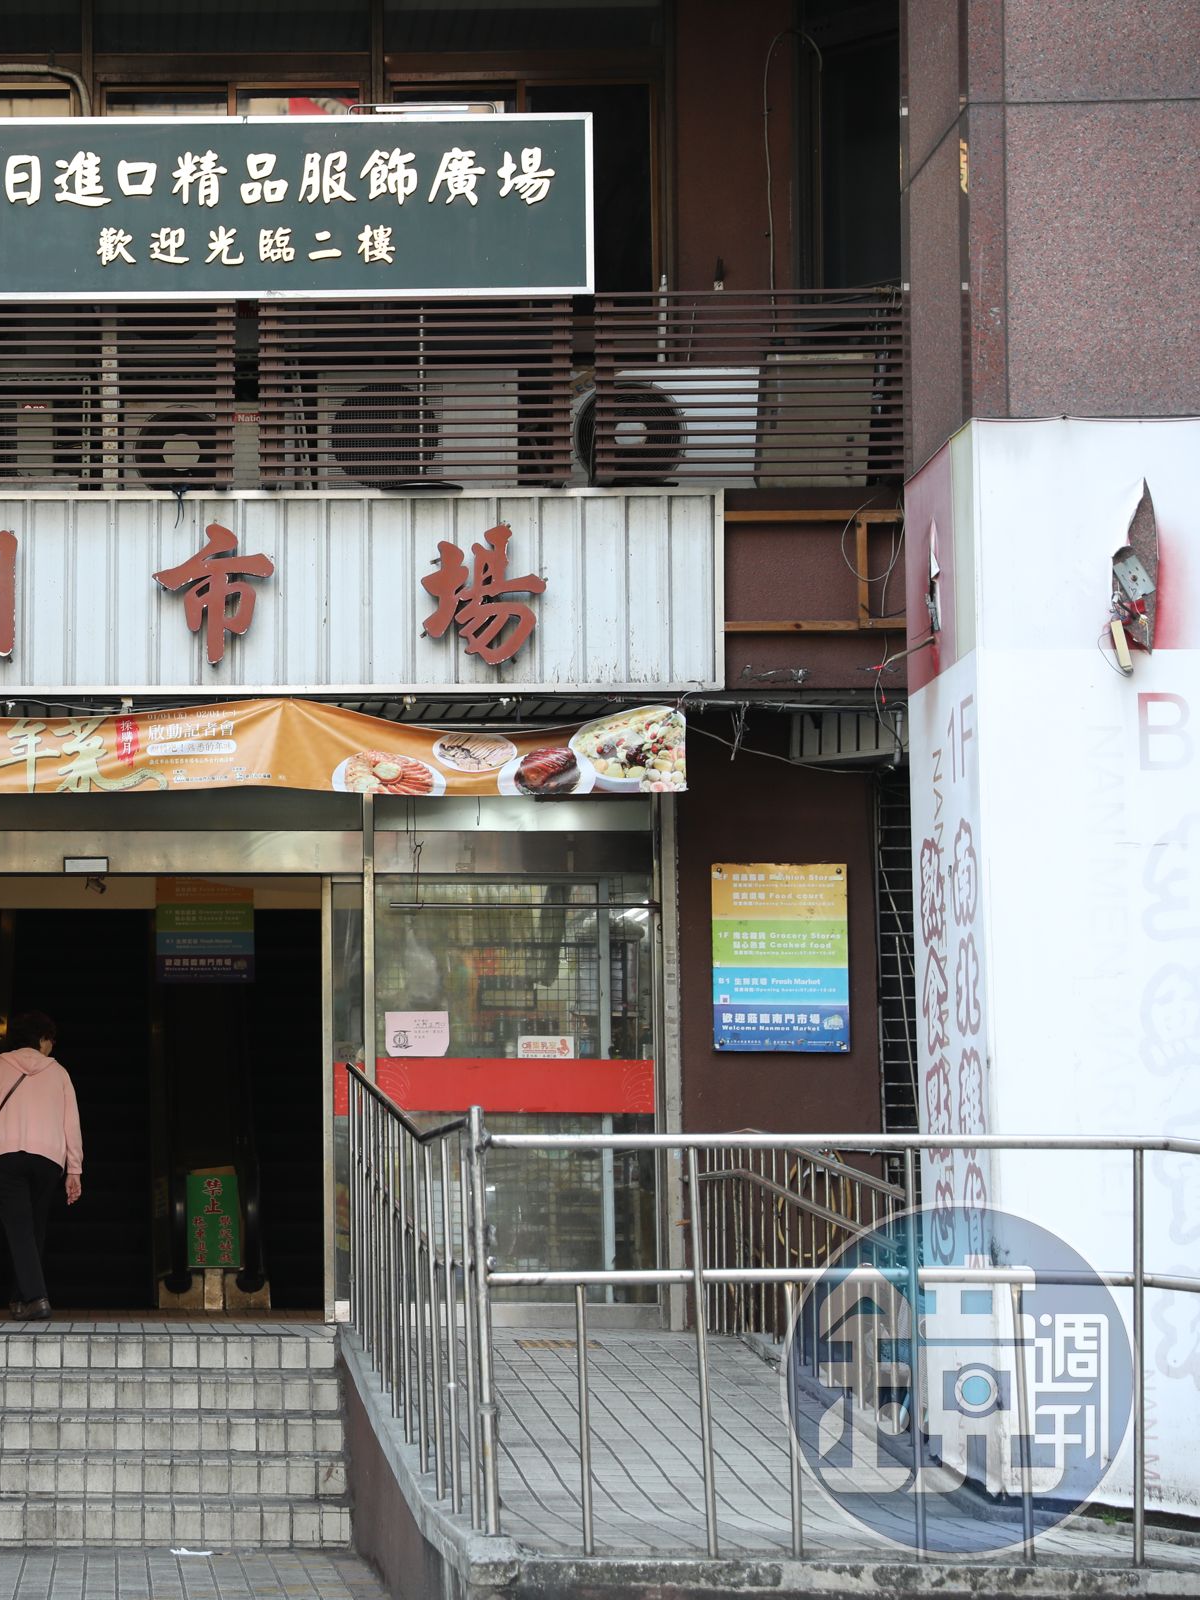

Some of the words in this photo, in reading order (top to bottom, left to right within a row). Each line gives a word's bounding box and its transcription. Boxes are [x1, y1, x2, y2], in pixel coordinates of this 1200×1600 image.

[97, 224, 396, 266] 歡迎光臨二樓
[947, 694, 974, 784] 1F
[202, 1177, 223, 1214] 禁止
